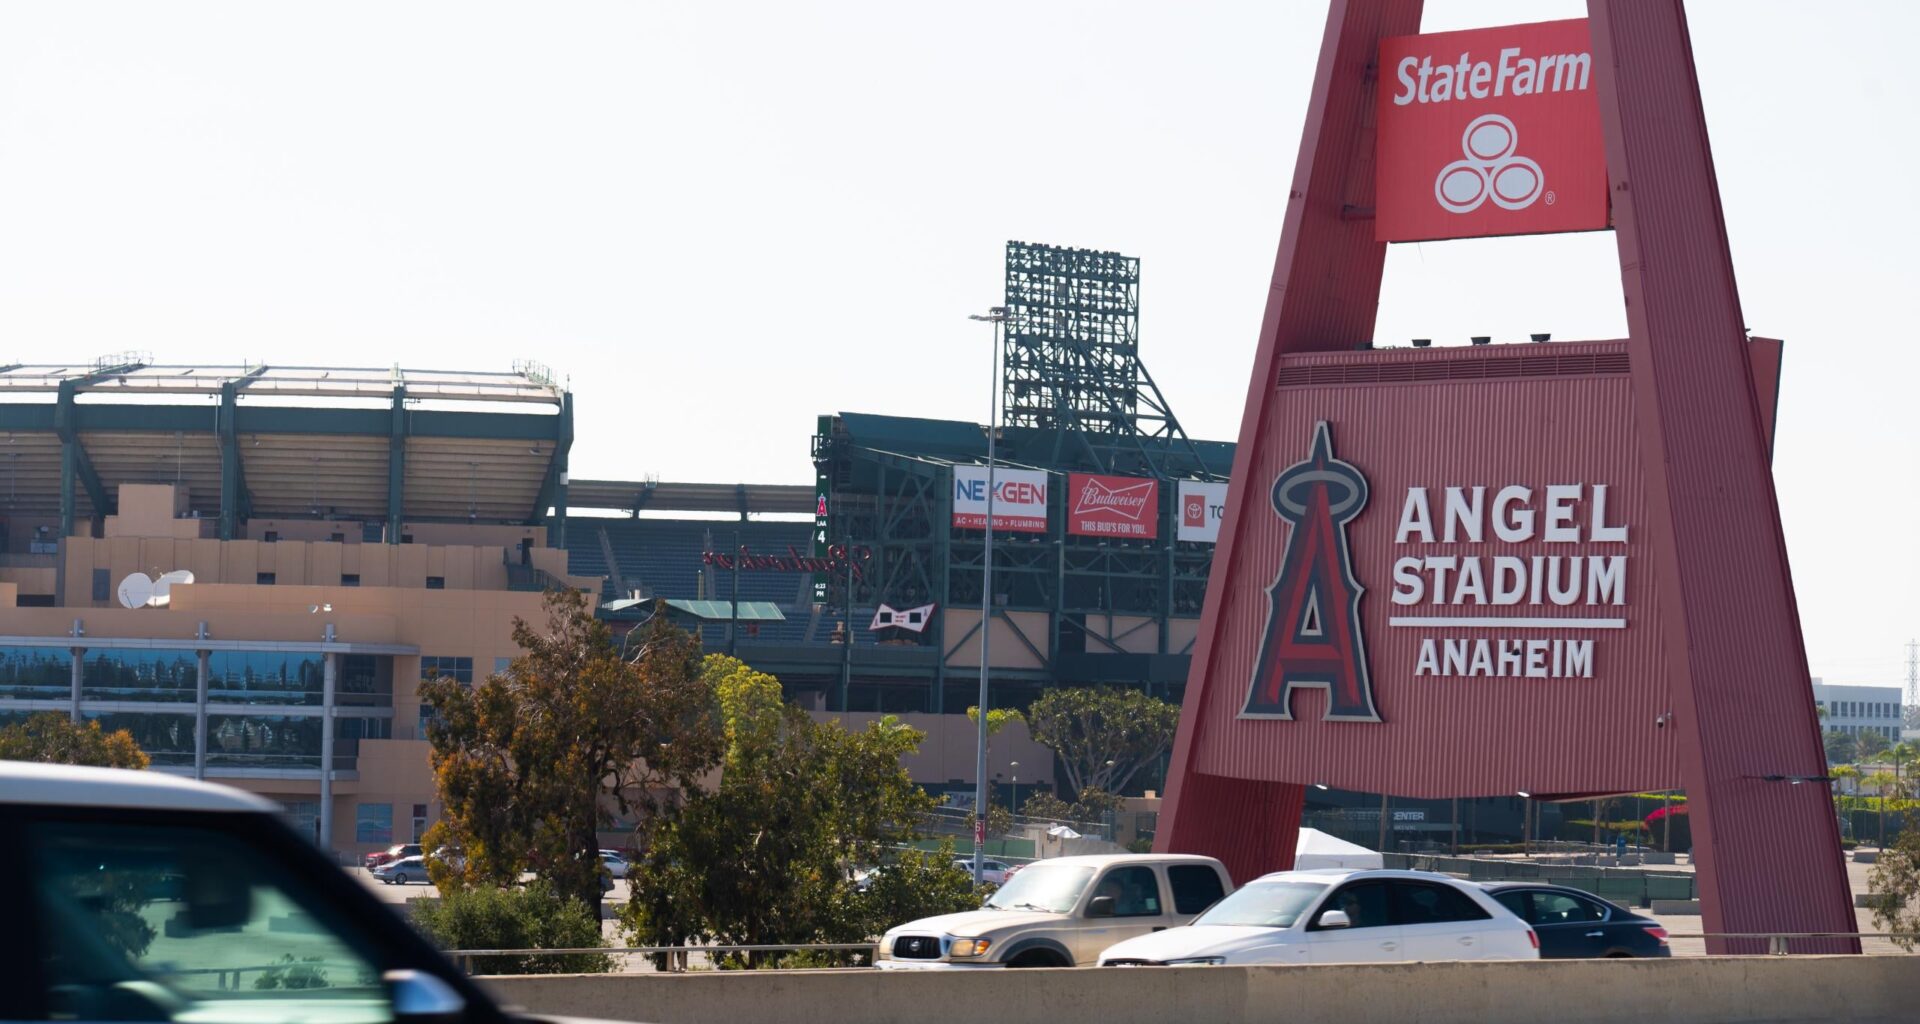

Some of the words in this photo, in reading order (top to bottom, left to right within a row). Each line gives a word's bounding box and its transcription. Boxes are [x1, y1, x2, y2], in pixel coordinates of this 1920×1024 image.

[956, 479, 1045, 505] NEXGEN
[1081, 486, 1146, 508] Budweiser
[956, 517, 967, 526] AC
[973, 517, 1004, 527] HEAING
[1010, 519, 1045, 530] PLUMBING
[1394, 483, 1629, 545] ANGEL
[818, 530, 826, 543] 4
[1081, 520, 1096, 532] THIS
[1097, 521, 1117, 533] BUD'S
[1118, 523, 1131, 534] FOR
[1132, 524, 1147, 535] YOU.
[1391, 555, 1627, 606] STADIUM
[816, 590, 825, 598] PM
[1415, 638, 1595, 679] ANAHEIM
